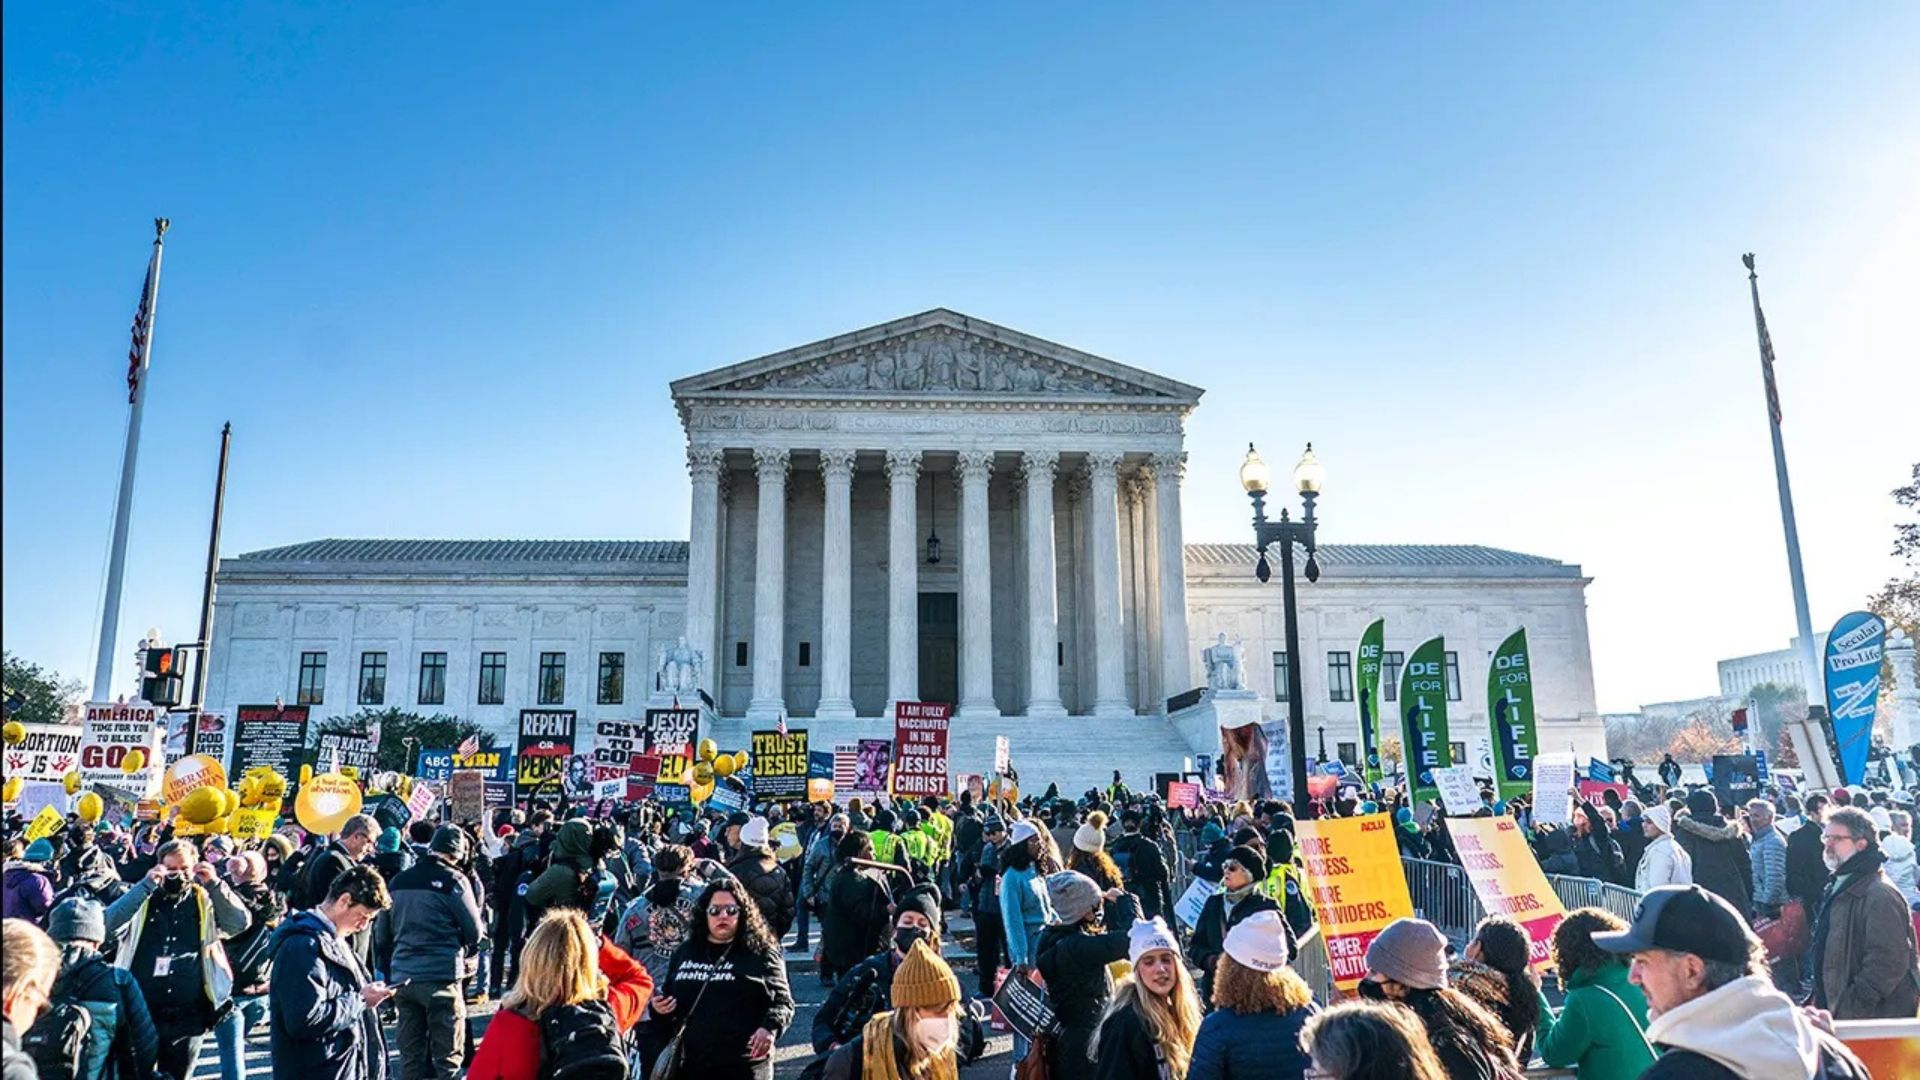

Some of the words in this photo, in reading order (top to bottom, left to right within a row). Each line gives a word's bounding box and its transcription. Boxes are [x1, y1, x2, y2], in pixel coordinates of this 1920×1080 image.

[1838, 624, 1878, 650] Secular
[1361, 645, 1380, 658] DE
[1409, 662, 1441, 676] DE
[1495, 653, 1525, 670] DE
[1832, 652, 1880, 670] Pro-Life
[1411, 681, 1441, 692] FOR
[1500, 672, 1528, 686] FOR
[87, 708, 156, 723] AMERICA
[901, 706, 907, 716] I
[906, 706, 921, 717] AM
[921, 706, 946, 717] FULLY
[91, 723, 112, 733] TIME
[114, 723, 131, 733] FOR
[133, 724, 149, 733] YOU
[522, 713, 574, 737] REPENT
[596, 721, 647, 739] CRY
[647, 712, 698, 732] JESUS
[898, 719, 948, 730] VACCINATED
[1418, 695, 1439, 766] LIFE
[1505, 688, 1530, 760] LIFE
[97, 734, 108, 743] TO
[111, 734, 142, 743] BLESS
[198, 733, 224, 743] GOD
[320, 734, 341, 749] GOD
[538, 740, 555, 750] OR
[608, 739, 633, 750] TO
[652, 731, 691, 744] SAVES
[752, 733, 807, 754] TRUST
[909, 731, 919, 742] IN
[920, 731, 936, 743] THE
[81, 745, 151, 769] GOD
[654, 743, 687, 755] FROM
[903, 744, 930, 756] BLOOD
[930, 744, 943, 756] OF
[31, 755, 48, 773] IS
[347, 751, 370, 766] THAT
[425, 755, 450, 767] ABC
[451, 753, 500, 768] TURN
[520, 755, 564, 779] PERIS
[752, 754, 808, 776] JESUS
[896, 757, 947, 774] JESUS
[169, 766, 212, 790] LIBERATE
[895, 776, 946, 793] CHRIST
[166, 773, 225, 802] ABORTION
[654, 785, 690, 797] KEEP
[1360, 819, 1386, 832] ACLU
[1496, 821, 1516, 832] ACLU
[1301, 837, 1334, 855] MORE
[1454, 834, 1483, 851] MORE
[1307, 856, 1355, 877] ACCESS.
[1463, 852, 1504, 870] ACCESS.
[1312, 885, 1343, 905] MORE
[1318, 901, 1392, 925] PROVIDERS.
[1328, 936, 1363, 958] FEWER
